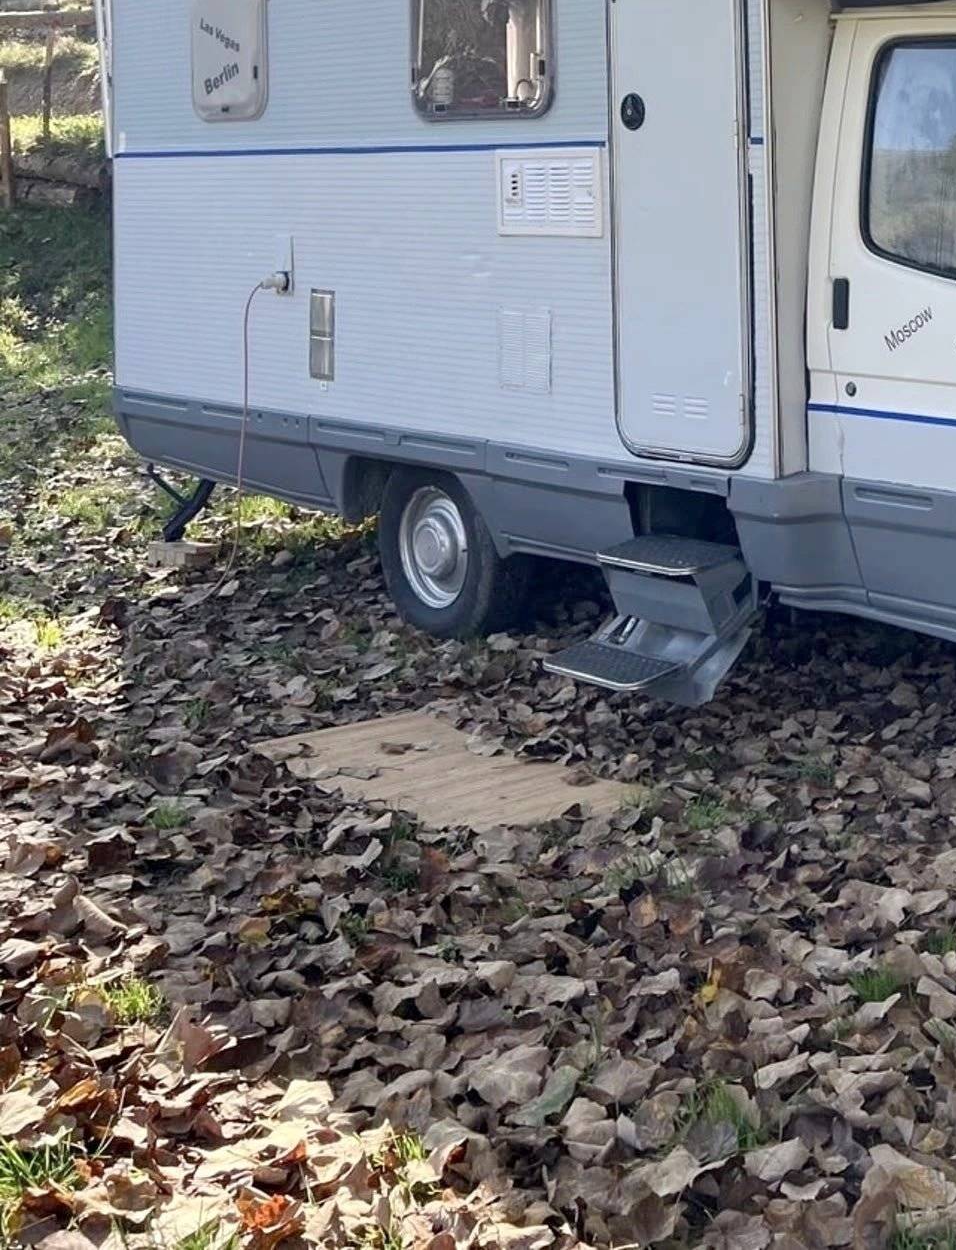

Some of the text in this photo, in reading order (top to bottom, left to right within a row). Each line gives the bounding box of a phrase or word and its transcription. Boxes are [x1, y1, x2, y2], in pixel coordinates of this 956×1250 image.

[200, 17, 240, 52] Las Vegas
[204, 62, 240, 95] Berlin
[883, 306, 933, 352] Moscow
